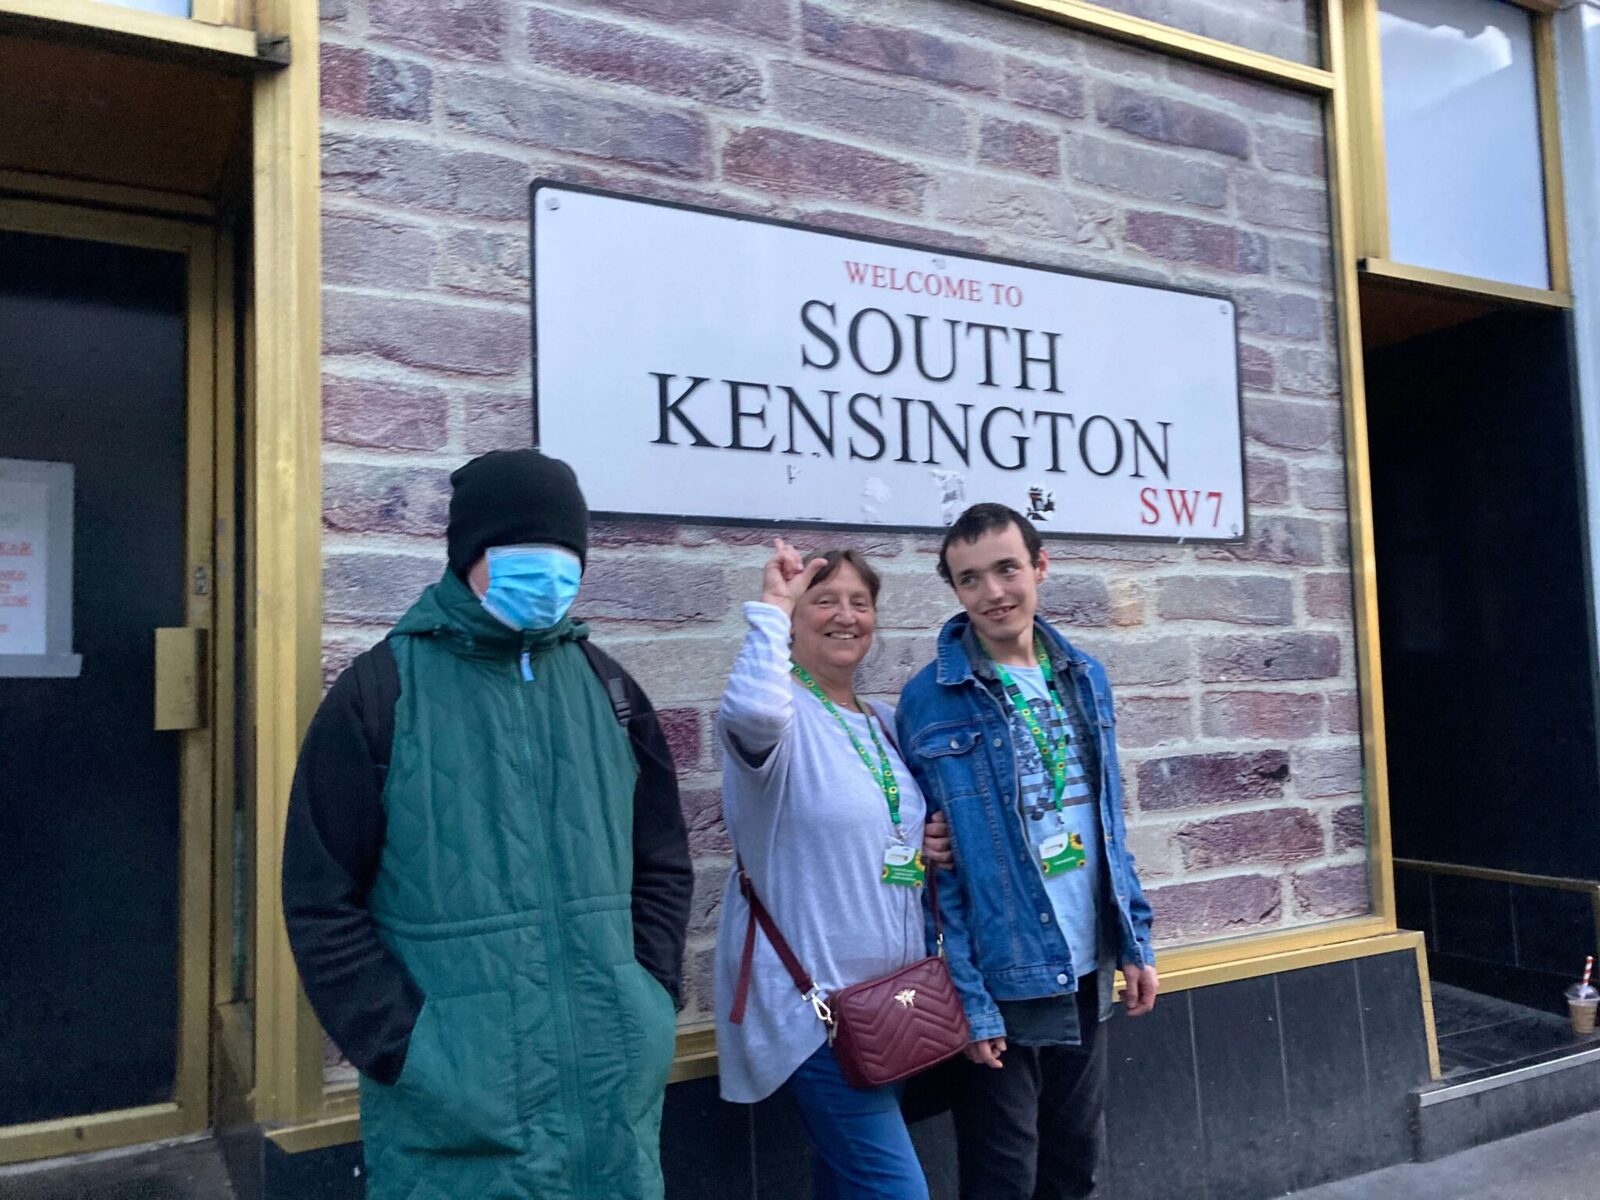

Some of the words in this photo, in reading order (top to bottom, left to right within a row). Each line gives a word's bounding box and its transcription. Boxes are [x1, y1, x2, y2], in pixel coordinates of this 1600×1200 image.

[845, 261, 982, 302] WELCOME
[991, 282, 1023, 307] TO
[801, 299, 1063, 393] SOUTH
[649, 371, 1172, 479] KENSINGTON
[1139, 486, 1224, 528] SW7
